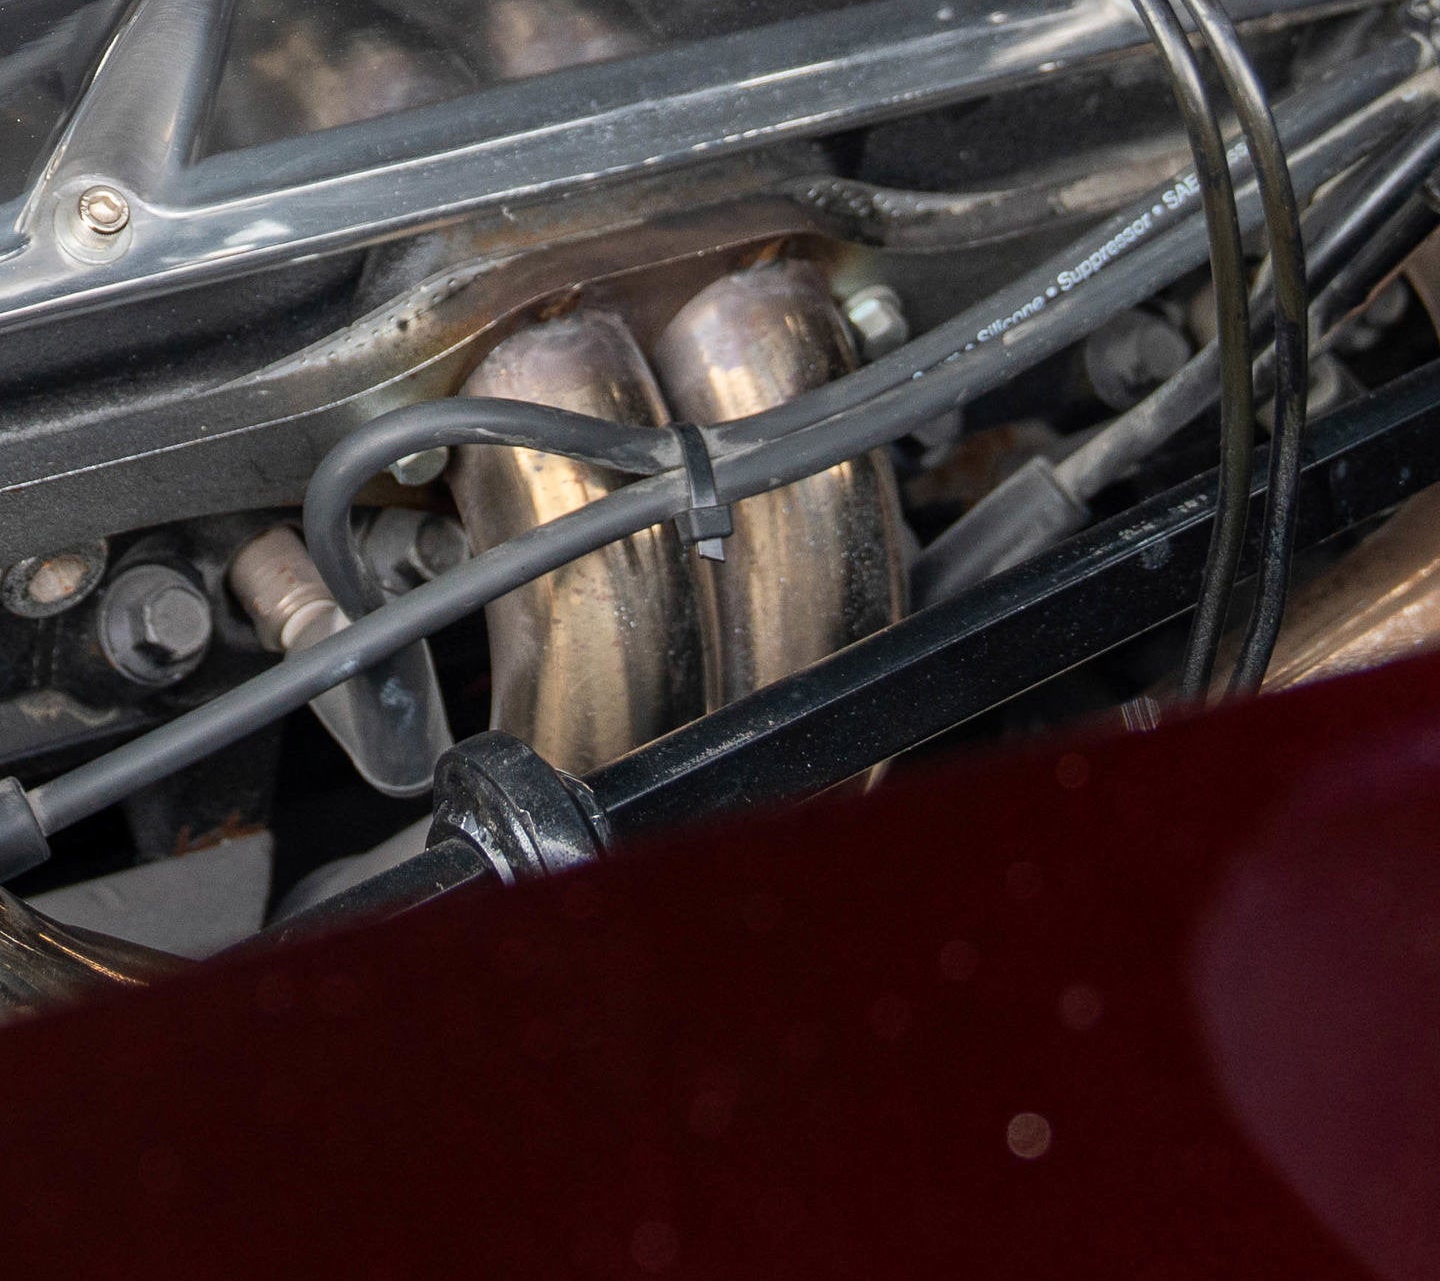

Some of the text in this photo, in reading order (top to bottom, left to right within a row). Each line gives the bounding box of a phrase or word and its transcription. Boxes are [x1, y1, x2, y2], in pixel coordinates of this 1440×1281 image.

[976, 172, 1201, 343] Silicone Suppressor SAE
